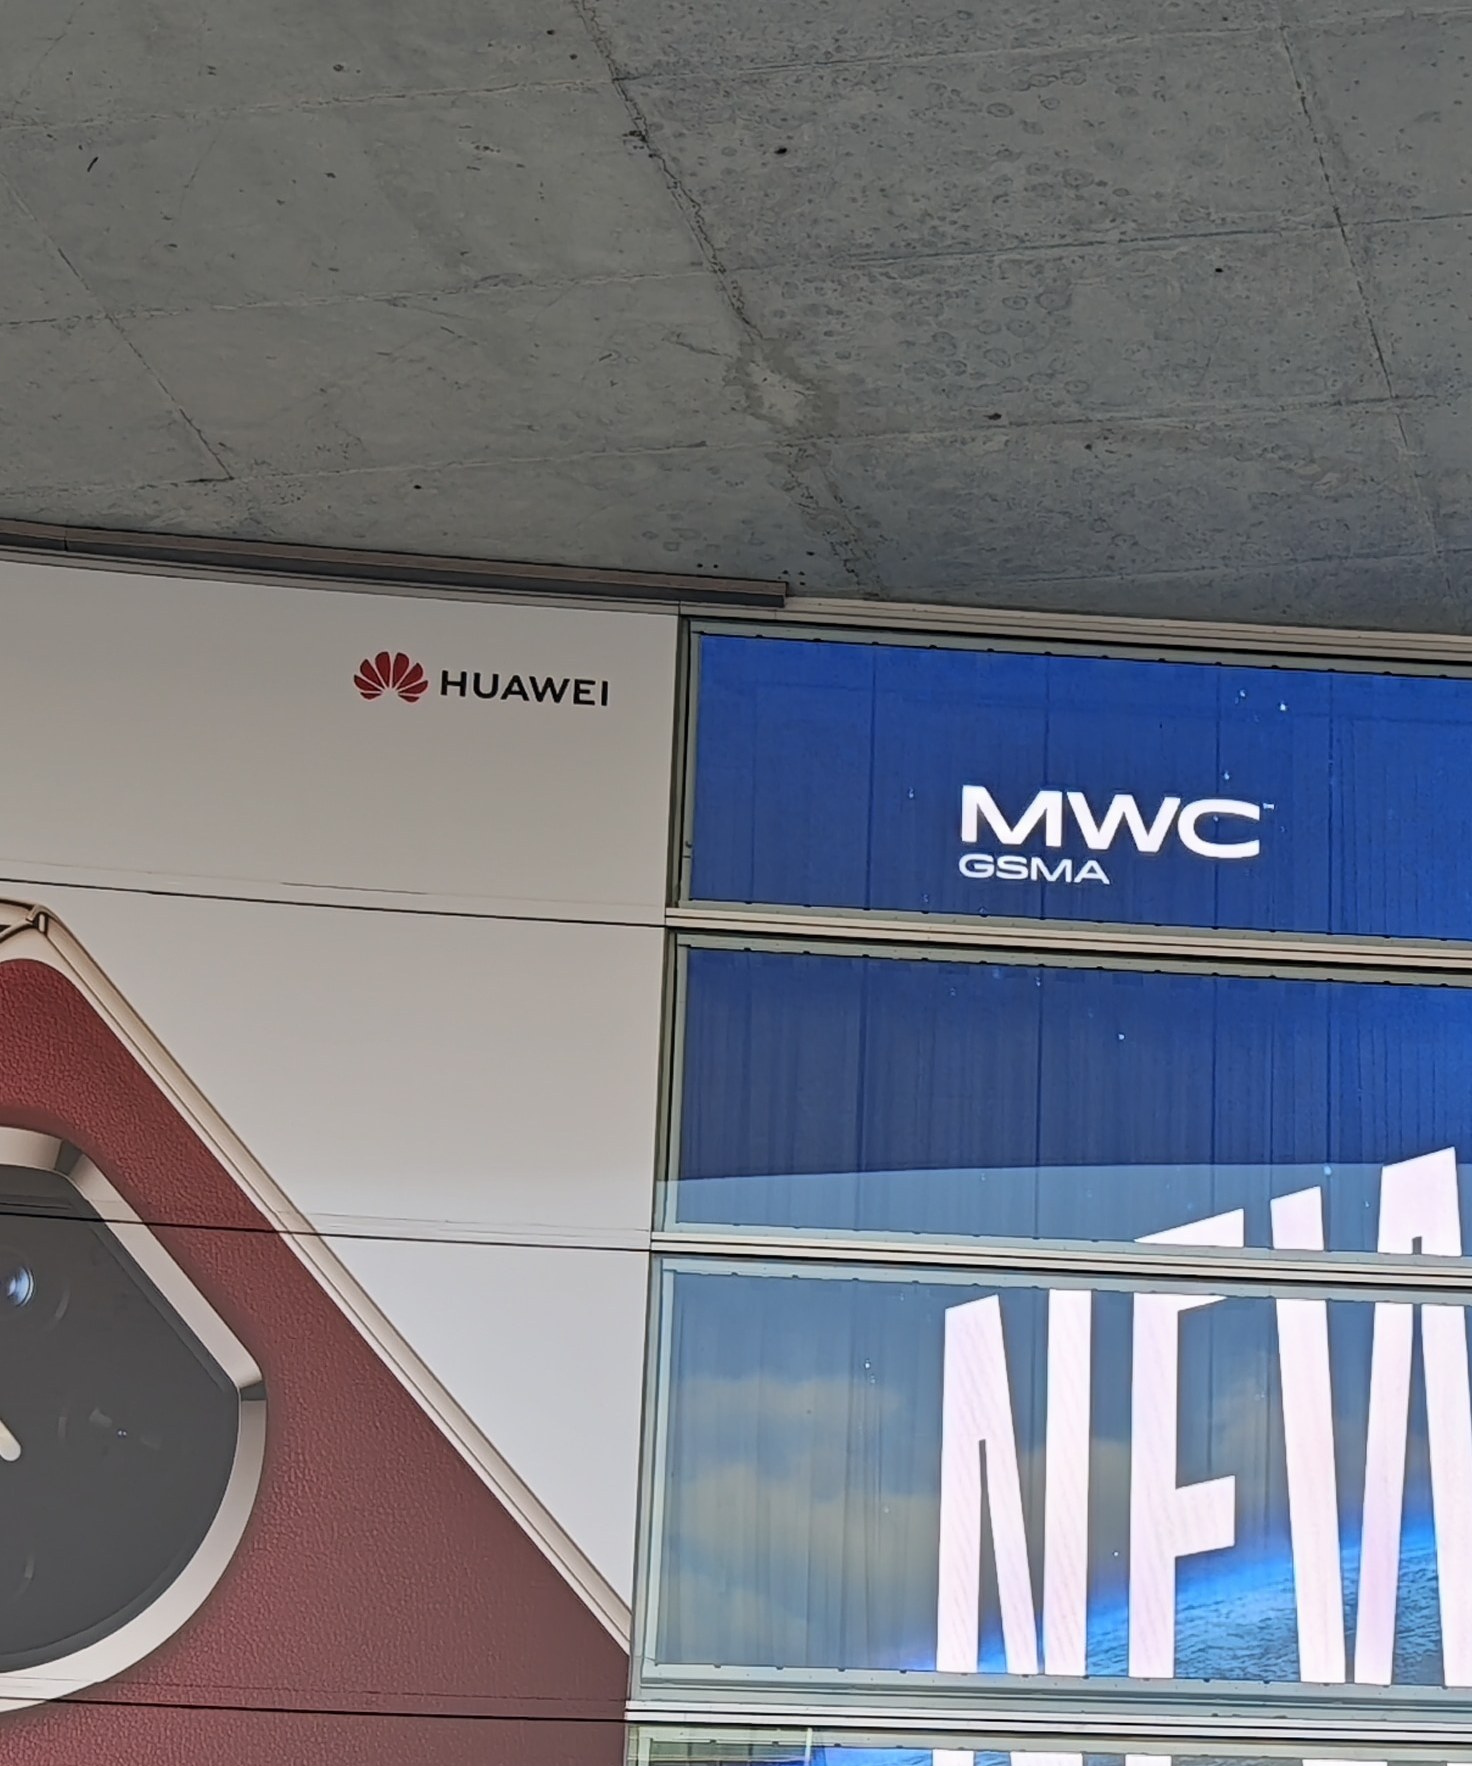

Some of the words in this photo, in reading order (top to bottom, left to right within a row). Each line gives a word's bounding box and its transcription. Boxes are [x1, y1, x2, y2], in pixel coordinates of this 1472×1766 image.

[439, 669, 609, 707] HUAWEI
[961, 784, 1260, 859] MWC
[958, 853, 1110, 885] GSMA
